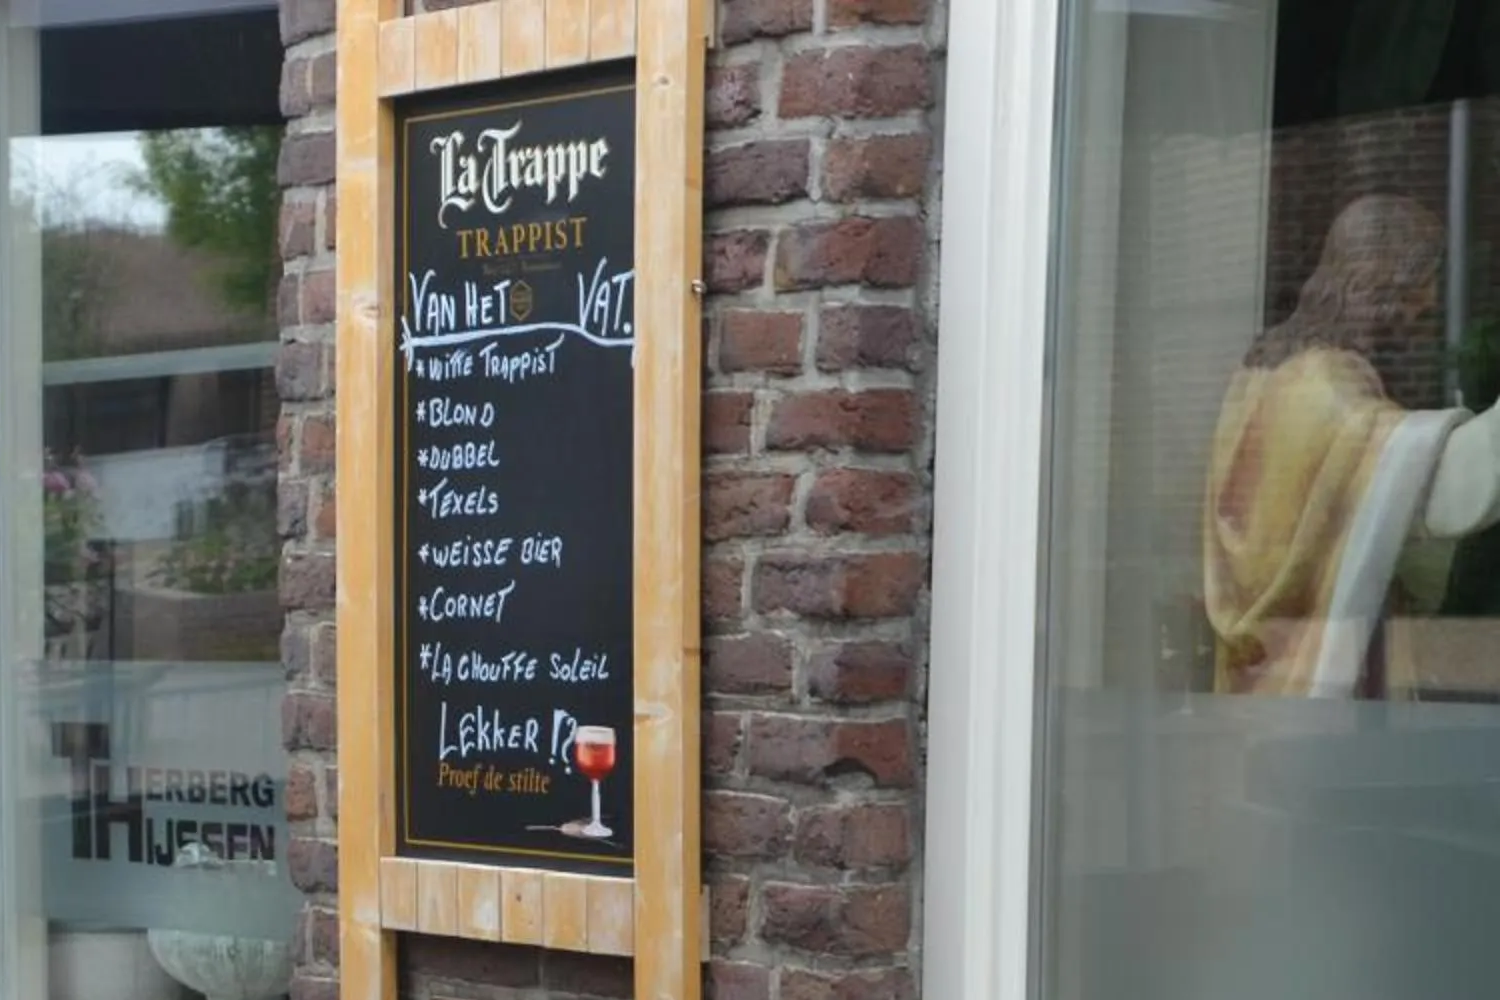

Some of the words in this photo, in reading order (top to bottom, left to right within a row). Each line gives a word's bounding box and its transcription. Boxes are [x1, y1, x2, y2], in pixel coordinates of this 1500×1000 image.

[457, 217, 587, 259] TRAPPIST
[410, 269, 455, 336] VAN
[464, 280, 511, 327] HET
[429, 397, 495, 428] BLOND
[429, 441, 500, 471] DUBBEL
[429, 580, 515, 622] CORNET
[439, 701, 538, 760] LEKKER
[437, 762, 482, 796] Proef
